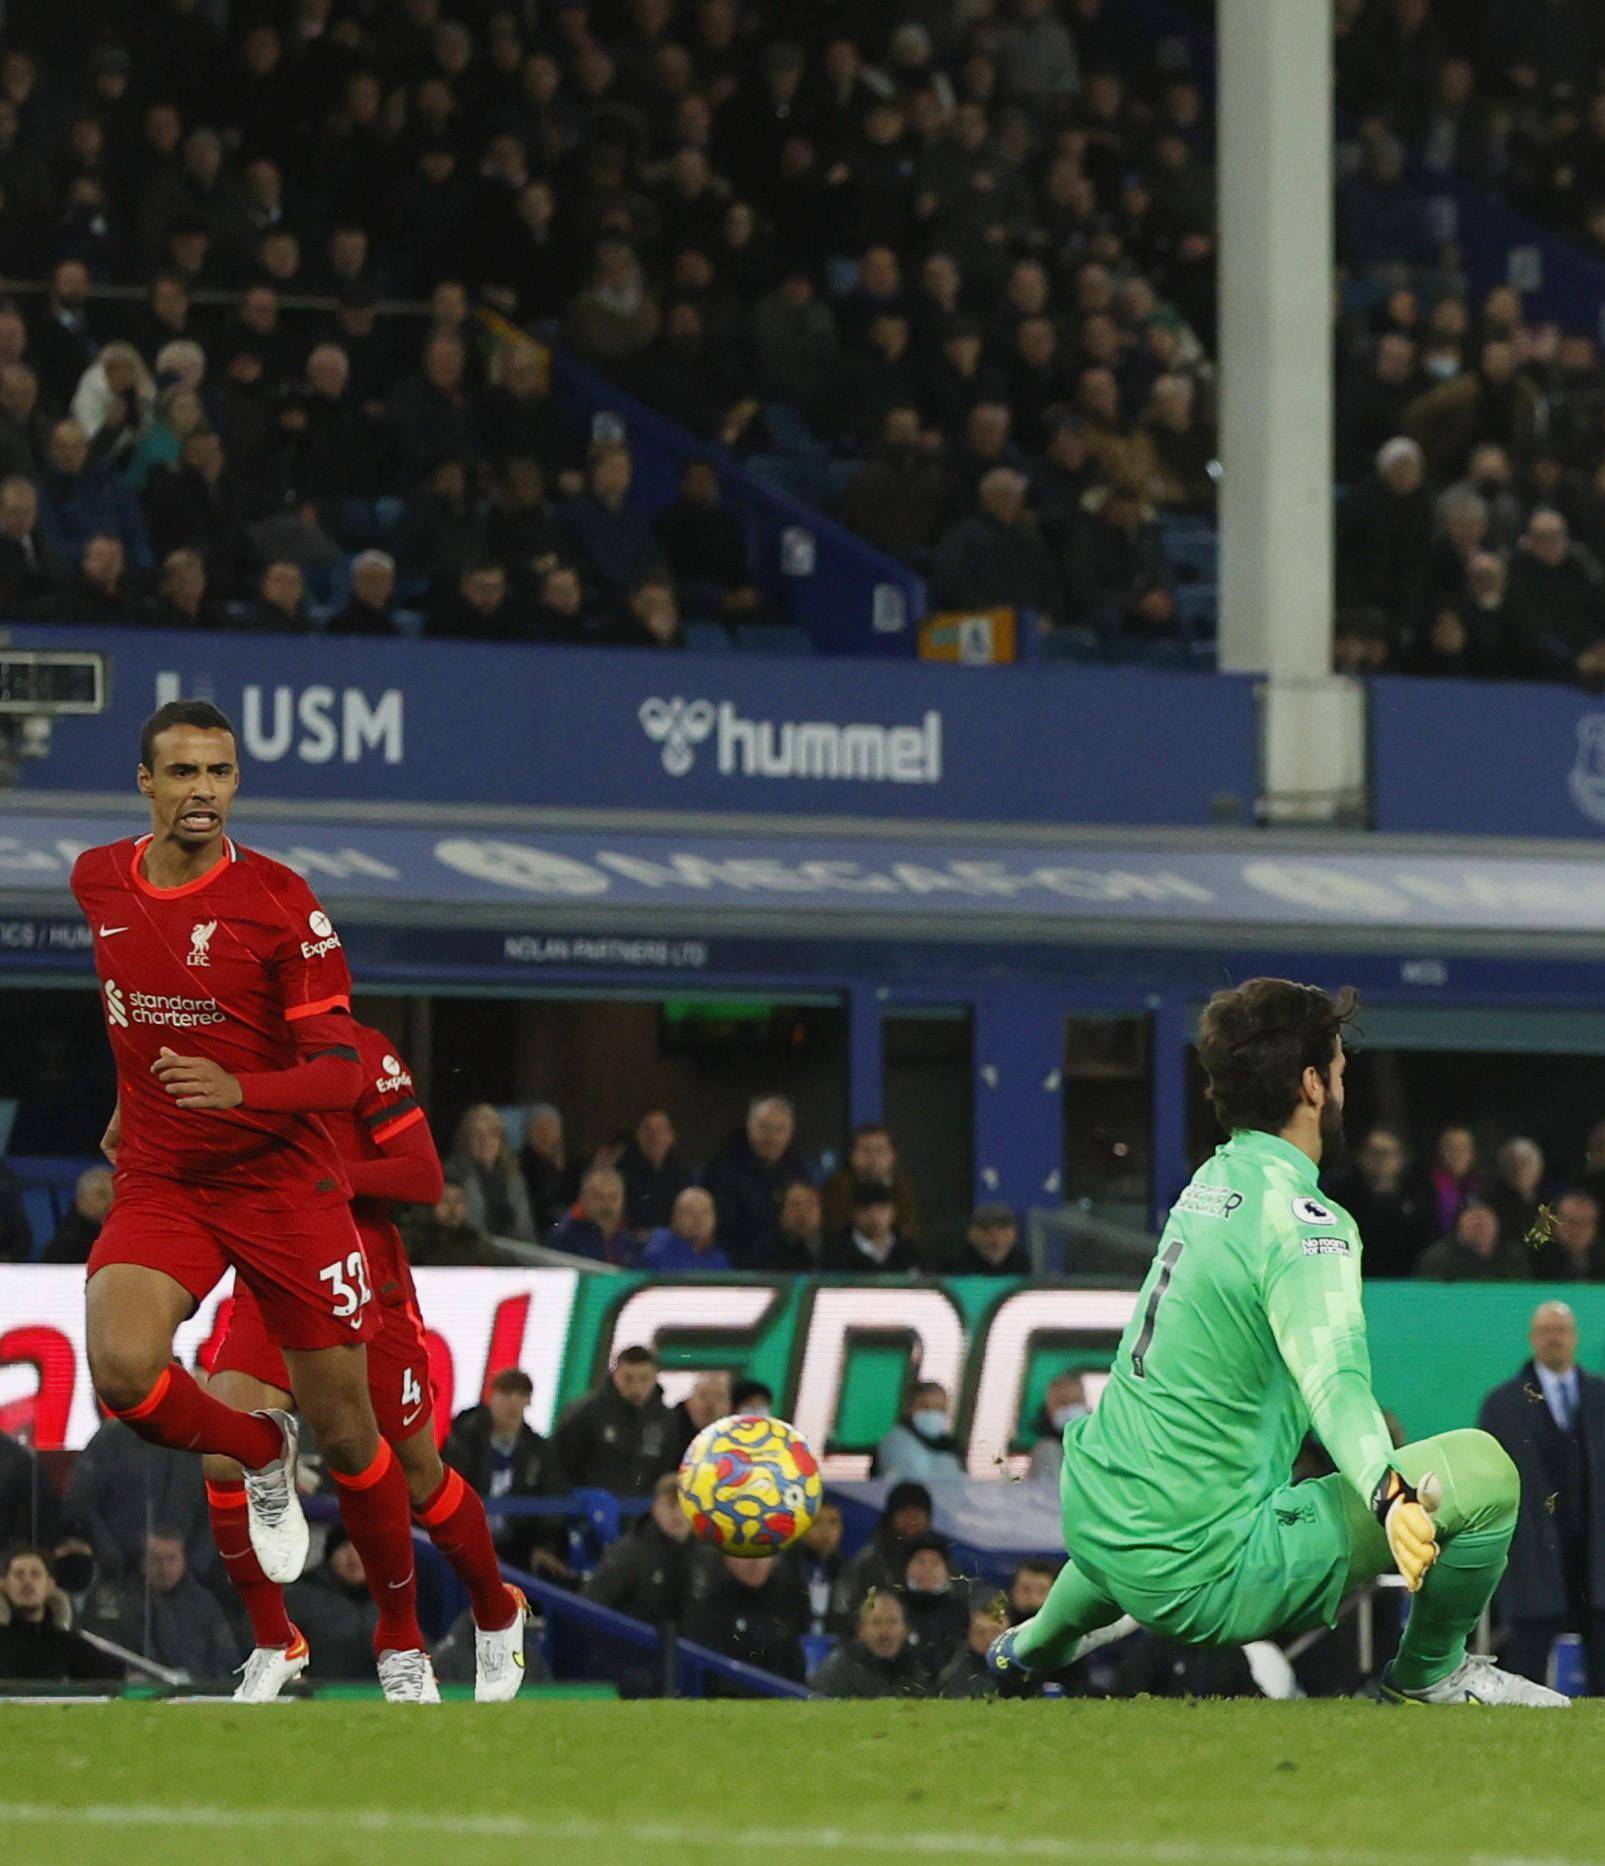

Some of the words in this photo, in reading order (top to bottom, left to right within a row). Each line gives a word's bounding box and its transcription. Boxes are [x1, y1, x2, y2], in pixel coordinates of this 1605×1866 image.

[242, 685, 404, 765] USM
[717, 702, 942, 784] hummel
[129, 991, 217, 1011] standard
[131, 1008, 227, 1027] chartered
[319, 1252, 371, 1317] 32
[401, 1367, 421, 1406] 4
